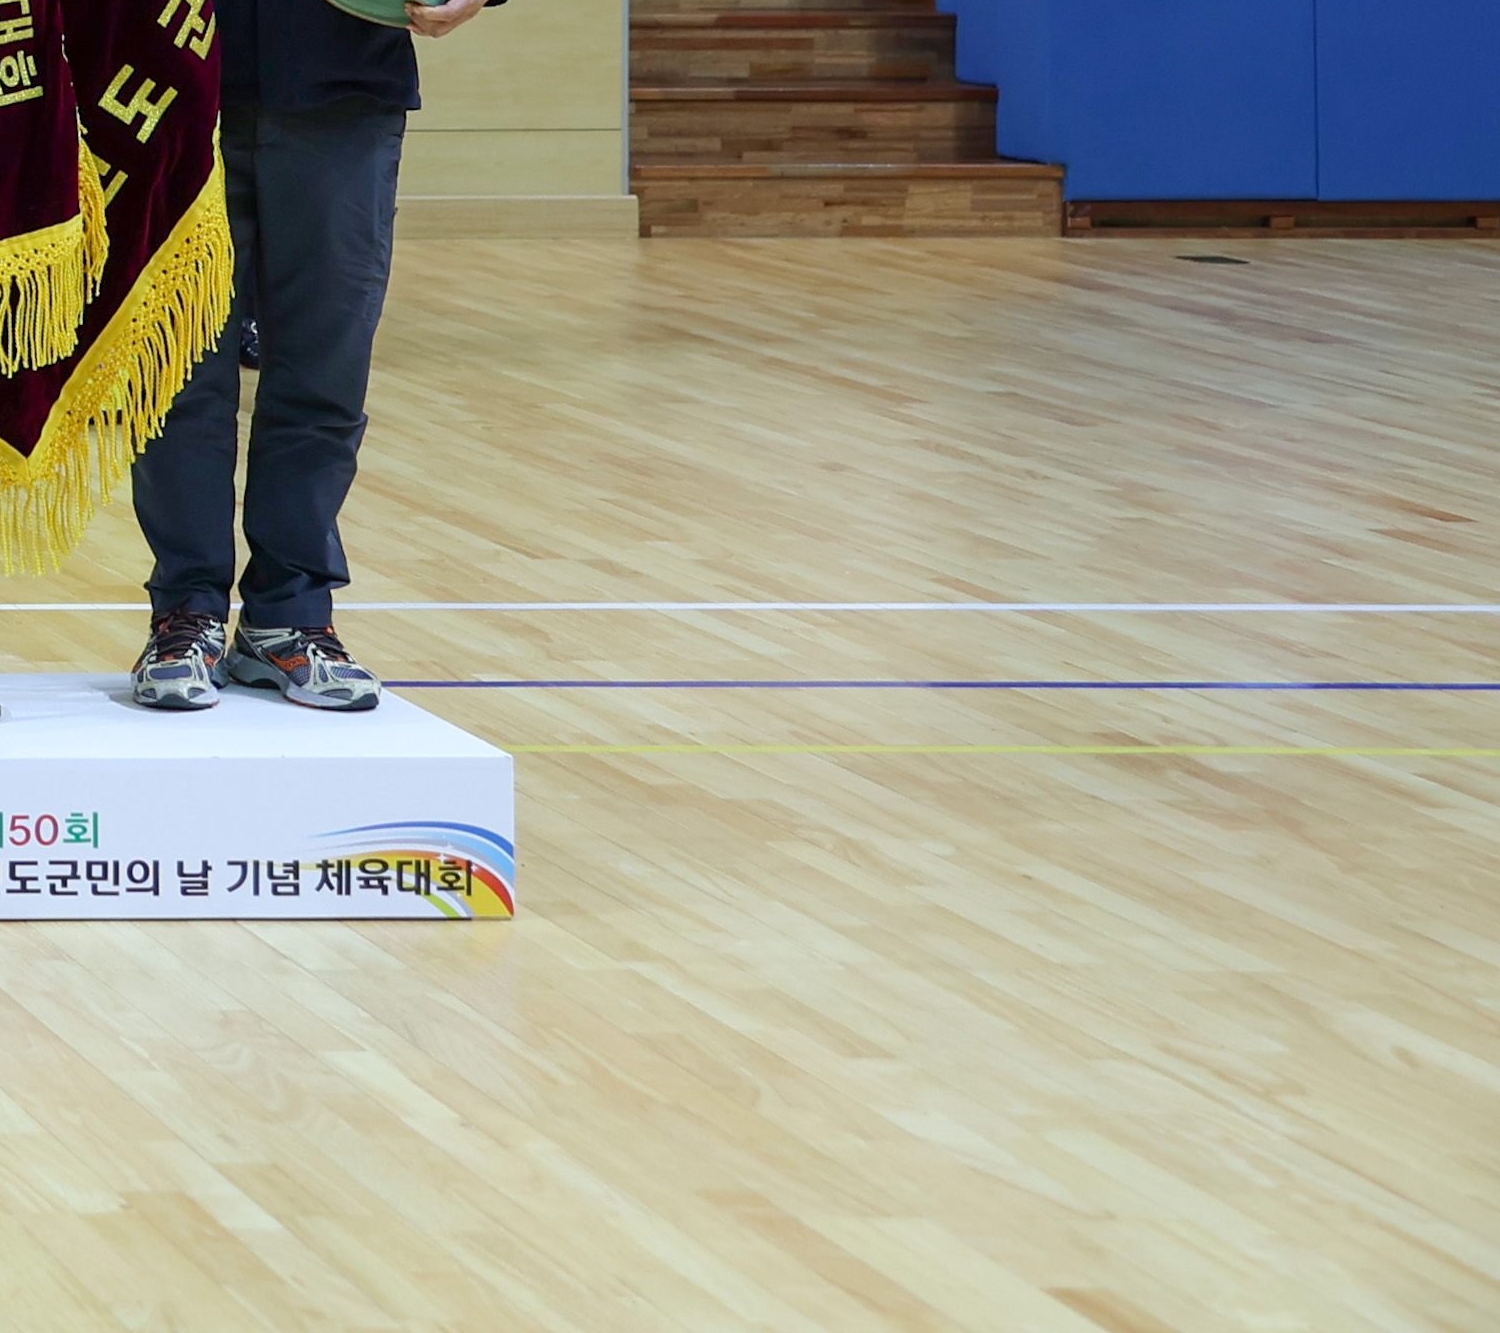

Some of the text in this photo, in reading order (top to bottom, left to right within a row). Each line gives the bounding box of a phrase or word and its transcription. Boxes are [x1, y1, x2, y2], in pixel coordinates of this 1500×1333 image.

[177, 859, 213, 897] 날
[225, 859, 301, 897] 기념
[314, 859, 474, 897] 체육대회
